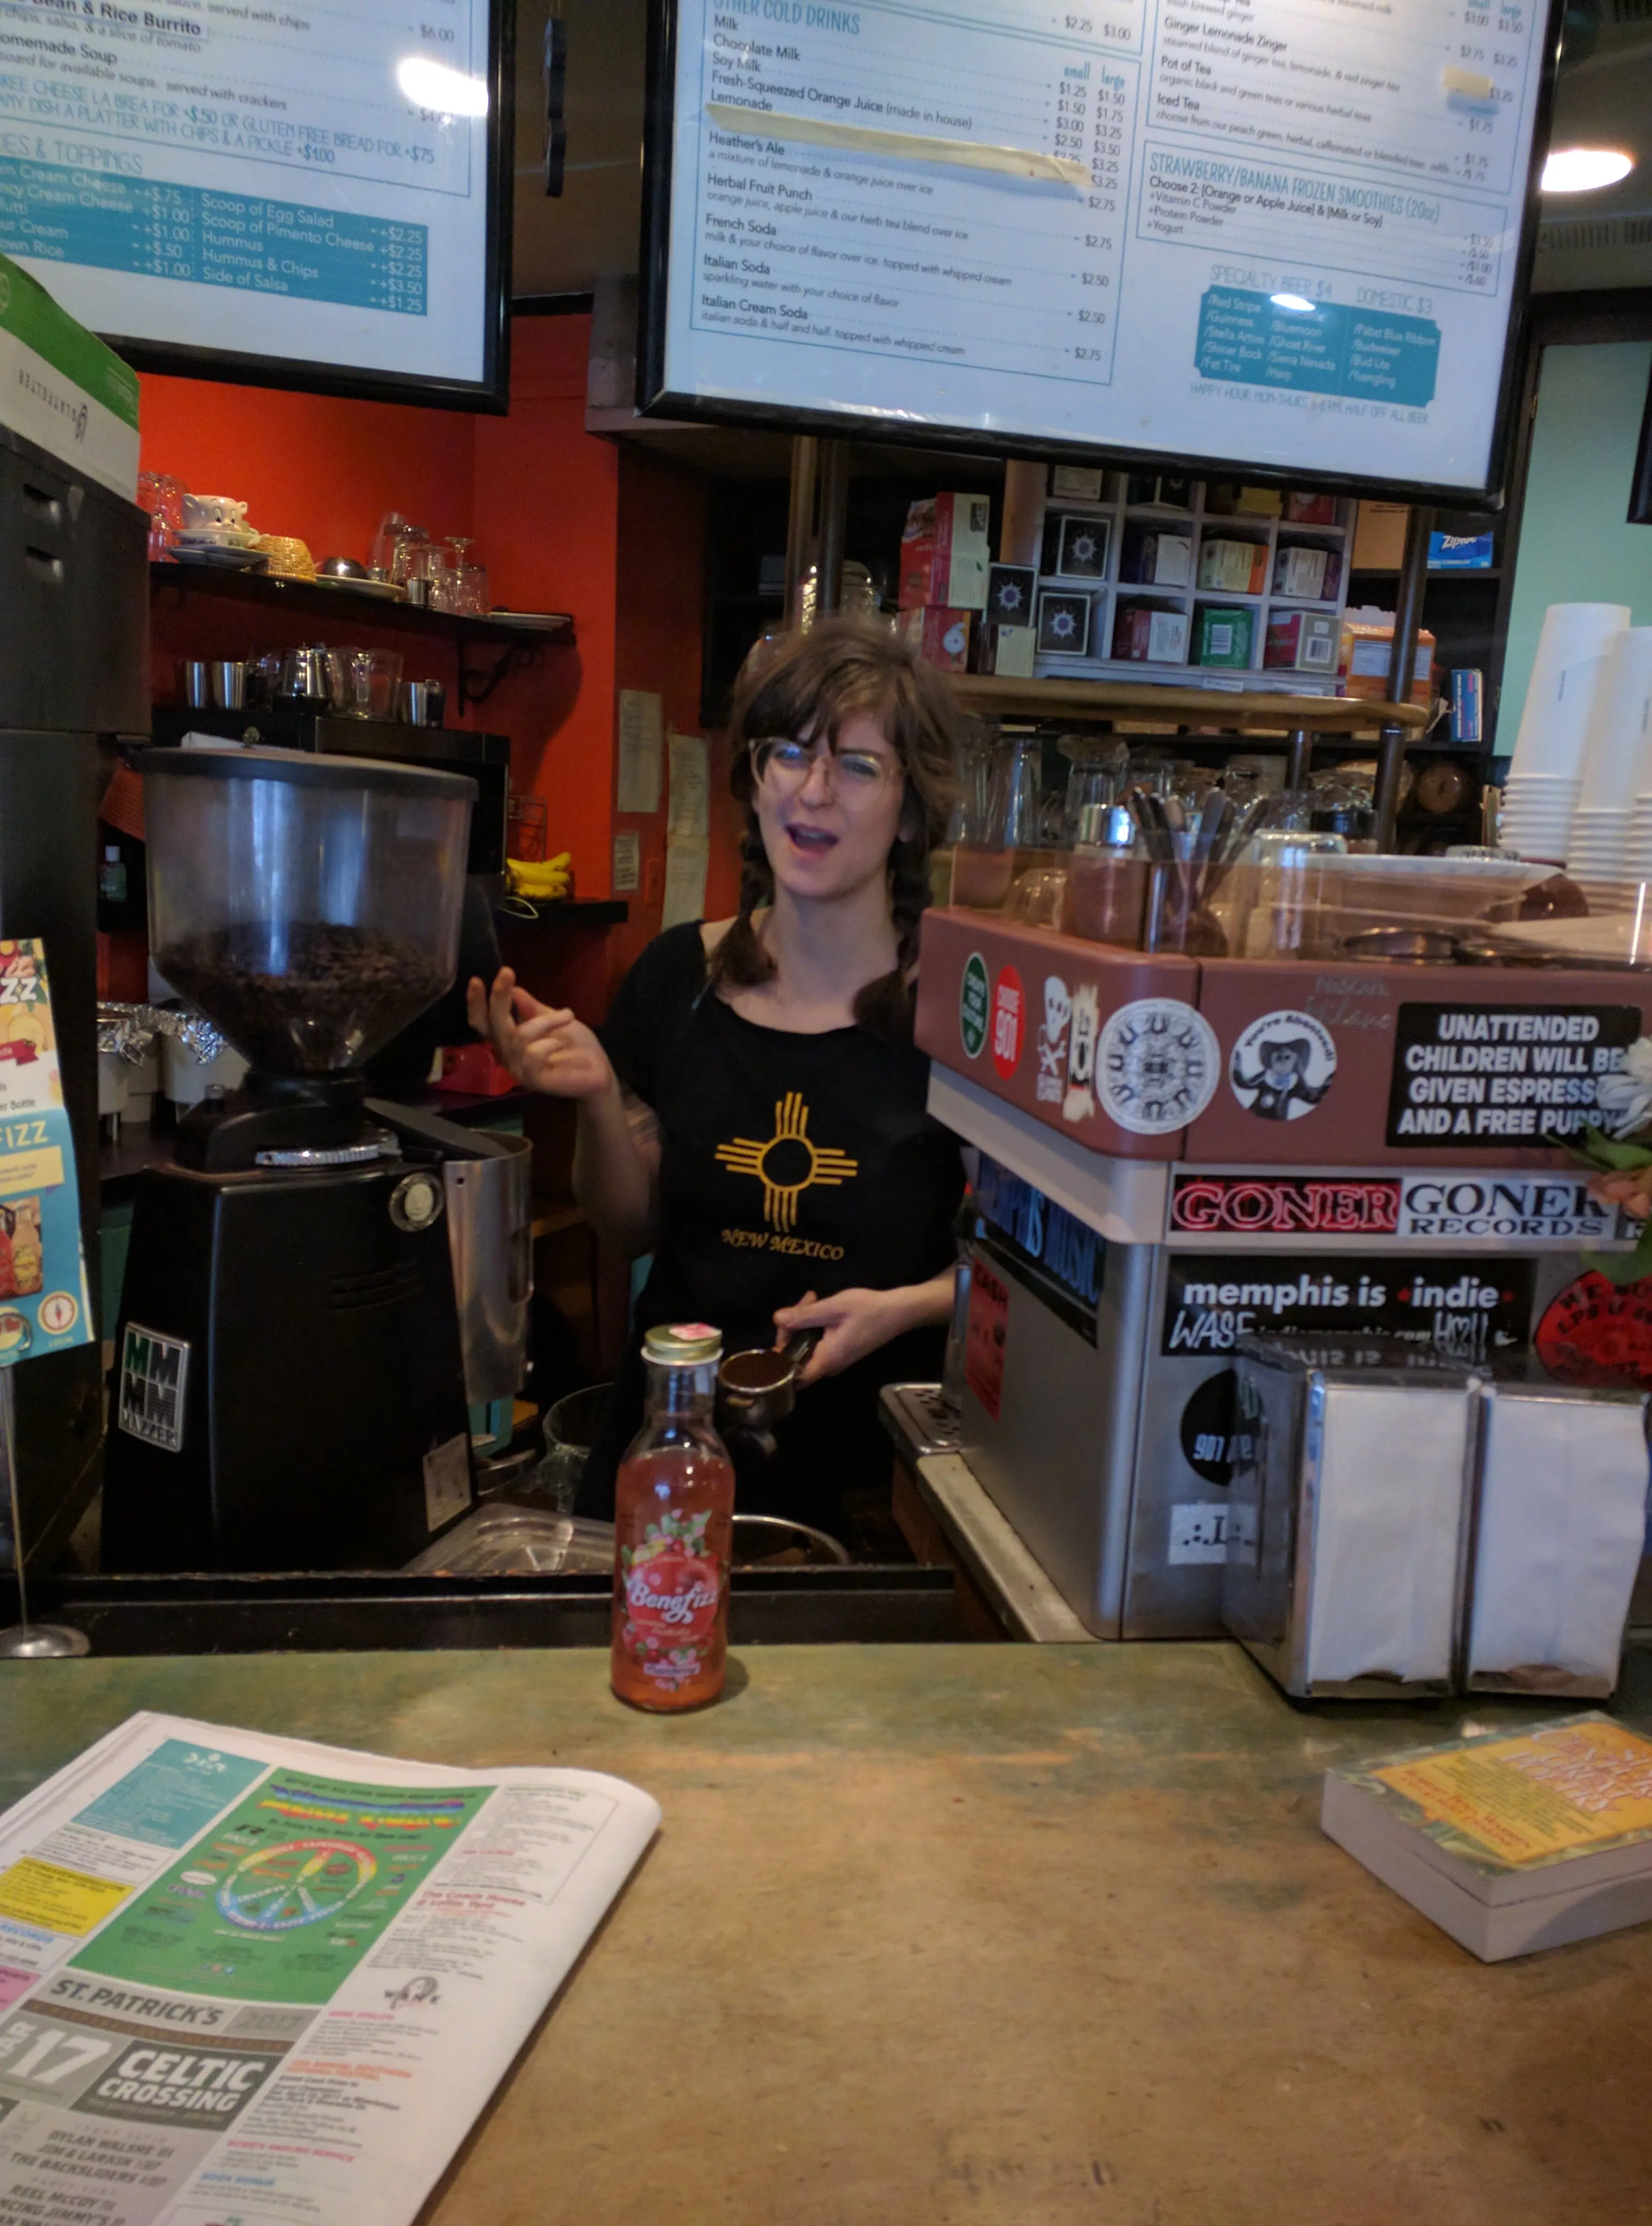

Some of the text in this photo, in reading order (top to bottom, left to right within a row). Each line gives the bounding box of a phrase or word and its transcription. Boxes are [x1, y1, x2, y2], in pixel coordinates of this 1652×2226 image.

[101, 6, 139, 24] Rice
[144, 11, 202, 36] Burrito
[279, 14, 311, 31] chips
[420, 24, 455, 44] $6.00
[764, 2, 802, 24] COLD
[806, 5, 860, 35] DRINKS
[1065, 15, 1131, 41] $2.25 $3.00
[1165, 16, 1287, 52] Ginger Lemonade Zinger
[80, 43, 118, 65] Soup
[714, 14, 1125, 105] Milk $1.25 $1.50
[1161, 55, 1212, 76] Pot of Tea
[713, 33, 1123, 123] Chocolate Milk $1.50 $1.75
[713, 52, 1122, 140] Soy Milk $3.00 $3.25
[239, 93, 287, 110] crackers
[712, 70, 1120, 157] Fresh-Squeezed Orange Juice (made in house) $2.50 $3.50
[1158, 92, 1200, 111] Iced Tea
[298, 125, 330, 146] FREE
[334, 133, 373, 153] BREAD
[377, 140, 401, 157] FOR
[711, 89, 1119, 173] Lemonade $3.25
[54, 141, 143, 176] TOPPINGS
[709, 132, 1115, 211] Heather's Ale $2.75
[1150, 152, 1288, 195] STRAWBERRY/BANANA
[1292, 177, 1335, 203] FROZEN
[1338, 185, 1403, 215] SMOOTHIES
[1150, 176, 1188, 194] Choose
[1244, 194, 1254, 204] or
[1256, 195, 1286, 210] Apple
[202, 193, 423, 245] Scoop of Egg Salad +$2.25
[707, 173, 1113, 250] Herbal Fruit Punch $2.75
[1190, 211, 1224, 226] Powder
[202, 212, 423, 261] Scoop of Pimento Cheese +$2.25
[202, 231, 423, 279] Hummus +$2.25
[706, 214, 1109, 289] French Soda $2.50
[203, 248, 423, 296] Hummus & Chips +$3.50
[203, 267, 423, 312] Side of Salsa +$1.25
[703, 254, 1106, 326] Italian Soda $2.50
[702, 294, 1102, 363] Italian Cream Soda $2.75
[1438, 1014, 1600, 1041] UNATTENDED
[1405, 1045, 1624, 1072] CHILDREN WILL BE
[1410, 1077, 1599, 1103] GIVEN ESPRESS
[1397, 1109, 1451, 1135] AND
[1453, 1109, 1471, 1135] A
[1475, 1109, 1536, 1134] FREE
[1173, 1184, 1398, 1230] GONER
[721, 1229, 845, 1261] NEW MEXICO
[1411, 1219, 1604, 1237] RECORDS
[1183, 1274, 1498, 1314] memphis is indie
[50, 1979, 85, 2001] ST.
[89, 1987, 225, 2026] PATRICK'S
[6, 2030, 111, 2083] 17
[118, 2049, 266, 2091] CELTIC
[97, 2079, 241, 2112] CROSSING
